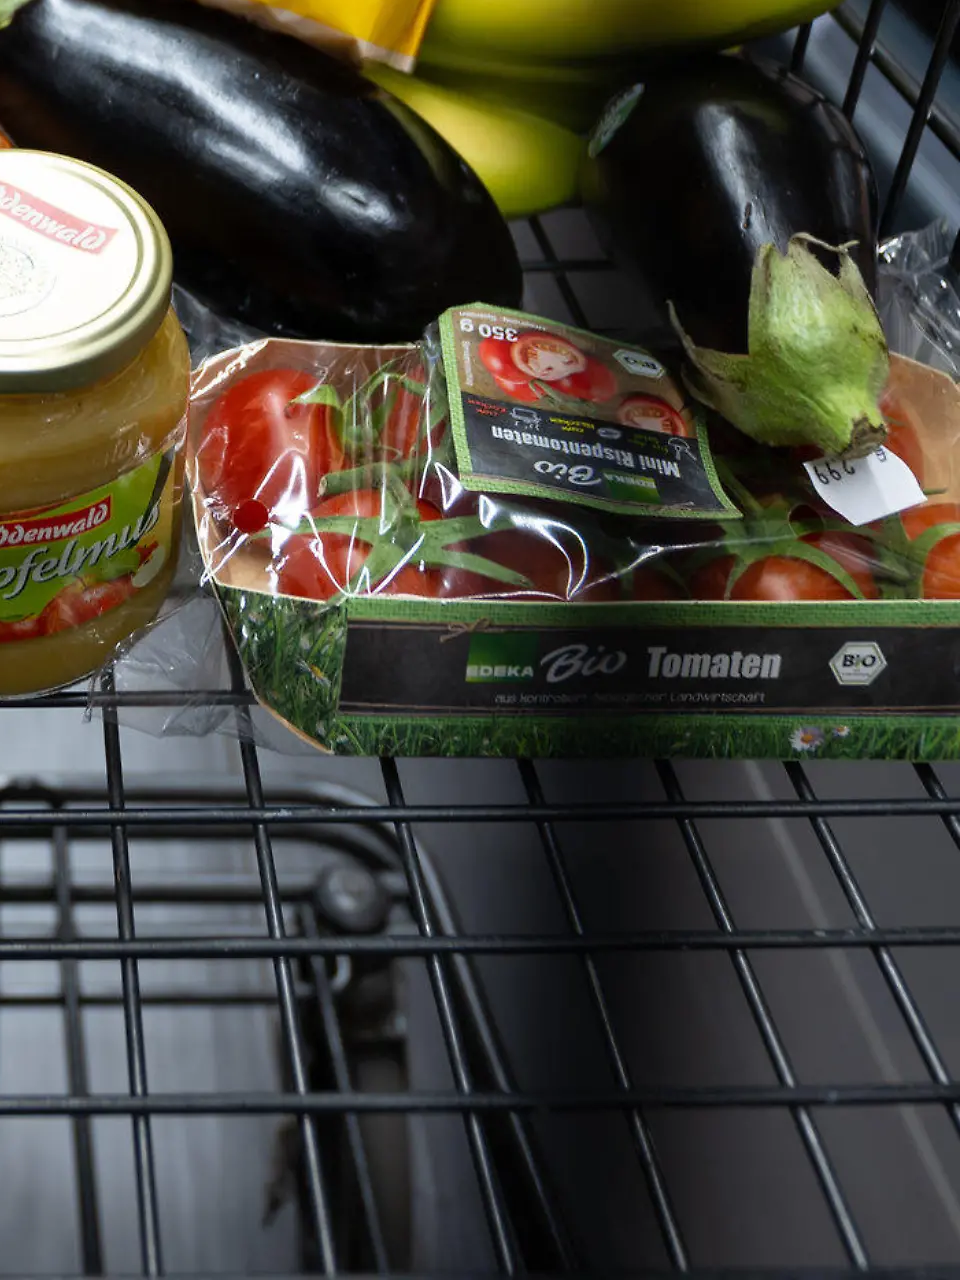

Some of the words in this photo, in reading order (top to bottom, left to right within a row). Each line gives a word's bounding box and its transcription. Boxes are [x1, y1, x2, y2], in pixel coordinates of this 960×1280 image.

[459, 318, 476, 334] g
[478, 323, 520, 343] 350
[491, 425, 633, 468] Rispentomaten
[533, 460, 600, 487] Bio
[639, 455, 680, 478] Mini
[540, 643, 627, 683] Bio
[647, 647, 783, 679] Tomaten
